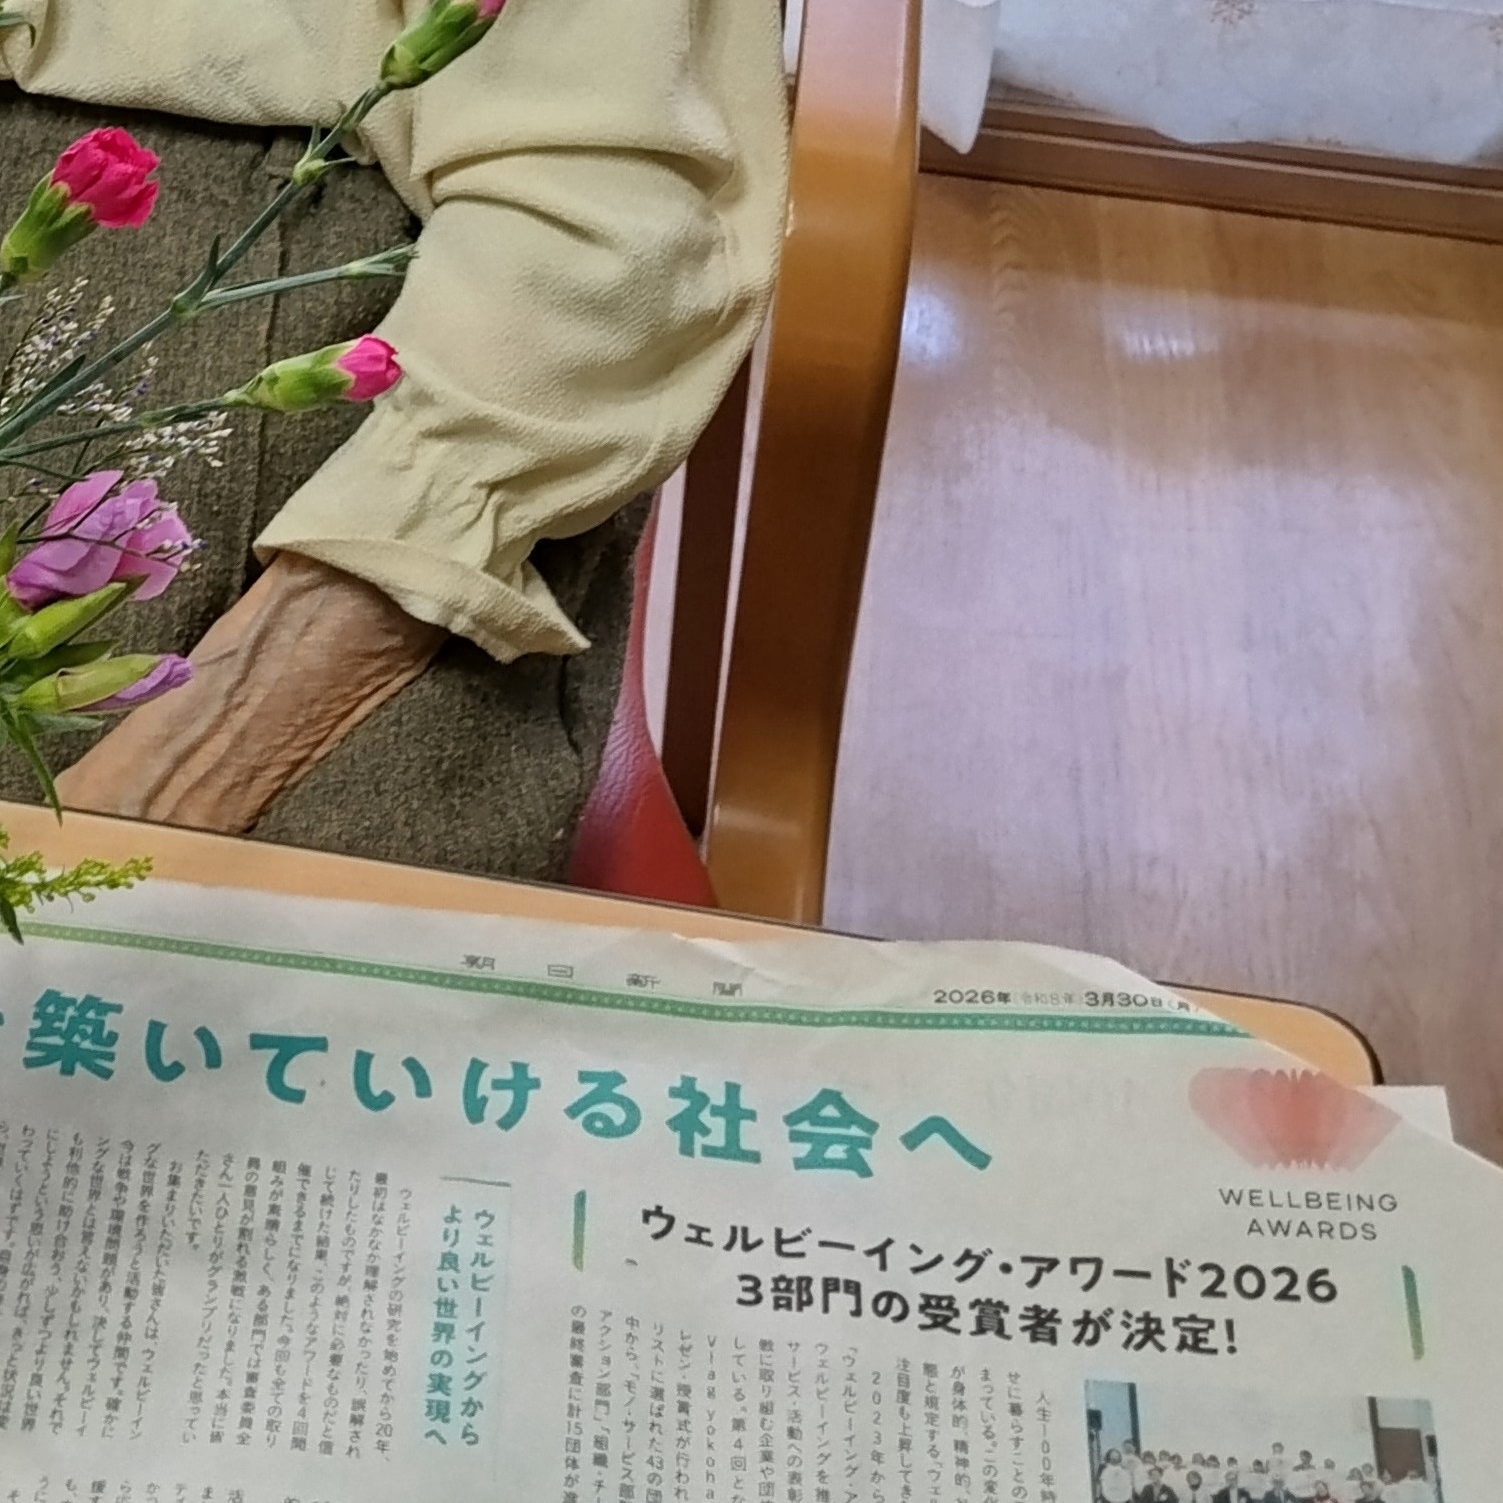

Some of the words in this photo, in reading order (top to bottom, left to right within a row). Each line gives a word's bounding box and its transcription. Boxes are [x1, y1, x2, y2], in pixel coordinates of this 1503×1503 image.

[933, 990, 1011, 1004] 2026年
[641, 1205, 1338, 1303] ウェルビーイング・アワード2026
[1219, 1188, 1398, 1212] WELLBEING
[1247, 1219, 1378, 1240] AWARDS
[424, 1205, 462, 1445] より良い世界の実現へ
[460, 1209, 495, 1446] ウェルビーイングから
[736, 1274, 1237, 1355] 3部門の受賞者が決定!
[758, 1339, 775, 1503] 戦に取り組む企業や団
[923, 1362, 943, 1503] 態と規定する「ウェ
[950, 1366, 971, 1503] が身体的、精神的、
